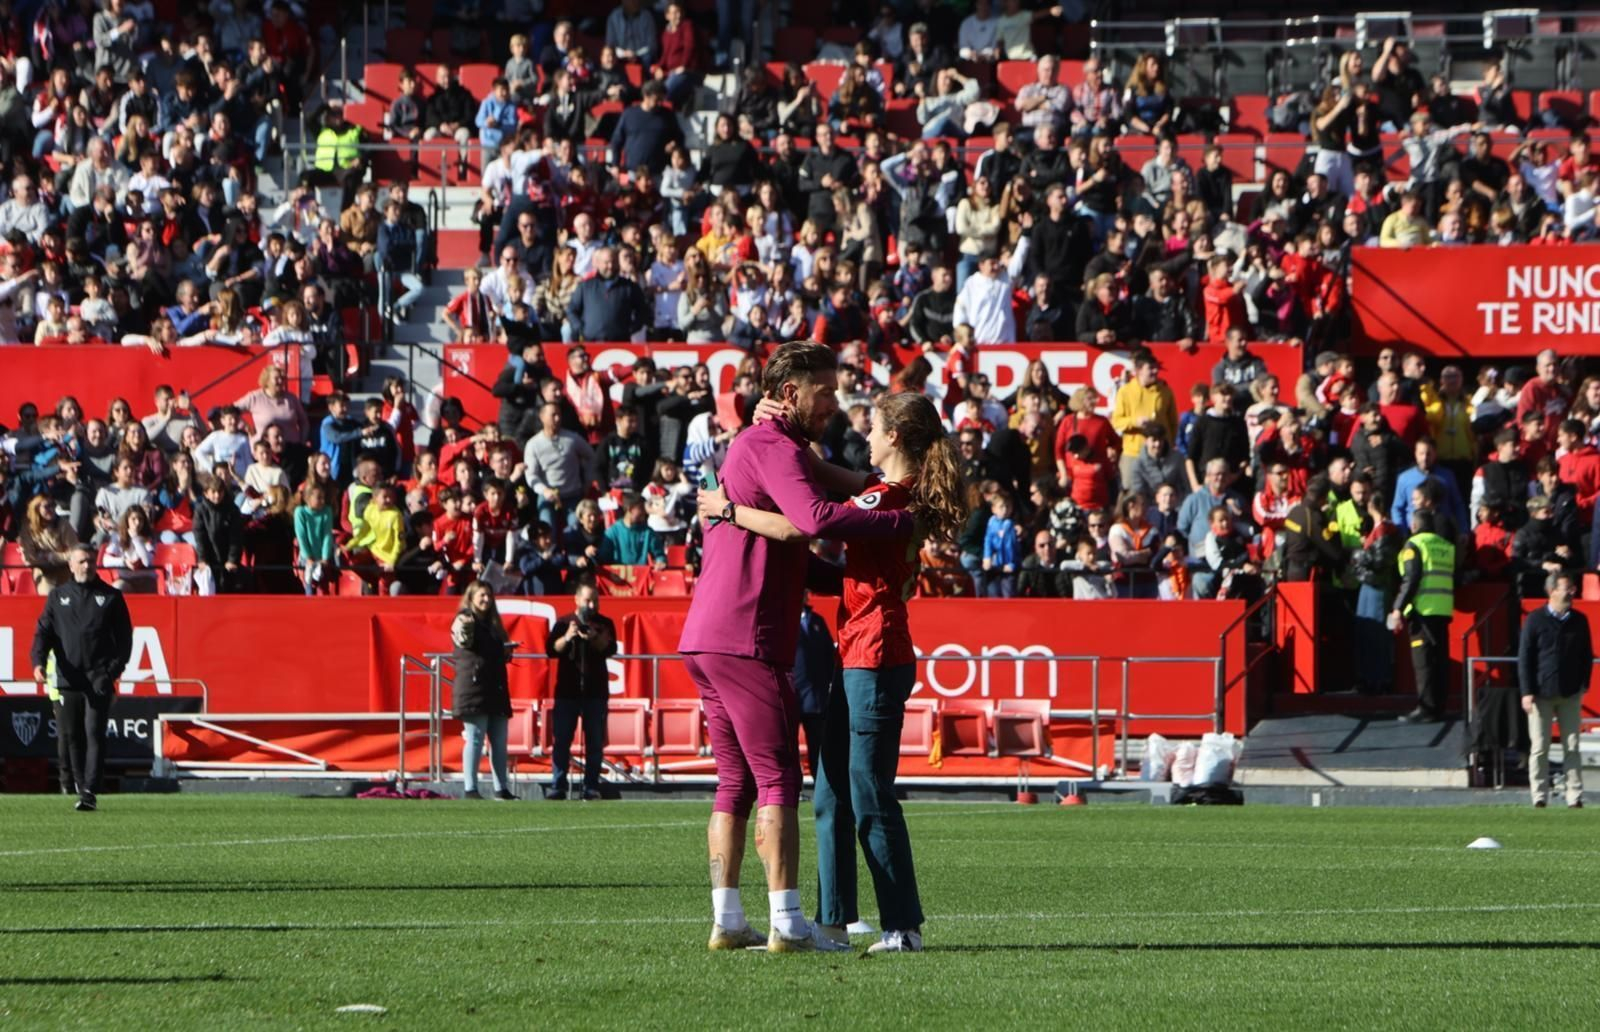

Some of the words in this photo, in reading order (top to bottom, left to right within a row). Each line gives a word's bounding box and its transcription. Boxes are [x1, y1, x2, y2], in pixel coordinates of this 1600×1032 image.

[1477, 302, 1521, 334] TE
[911, 643, 1058, 697] om
[123, 718, 148, 738] FC
